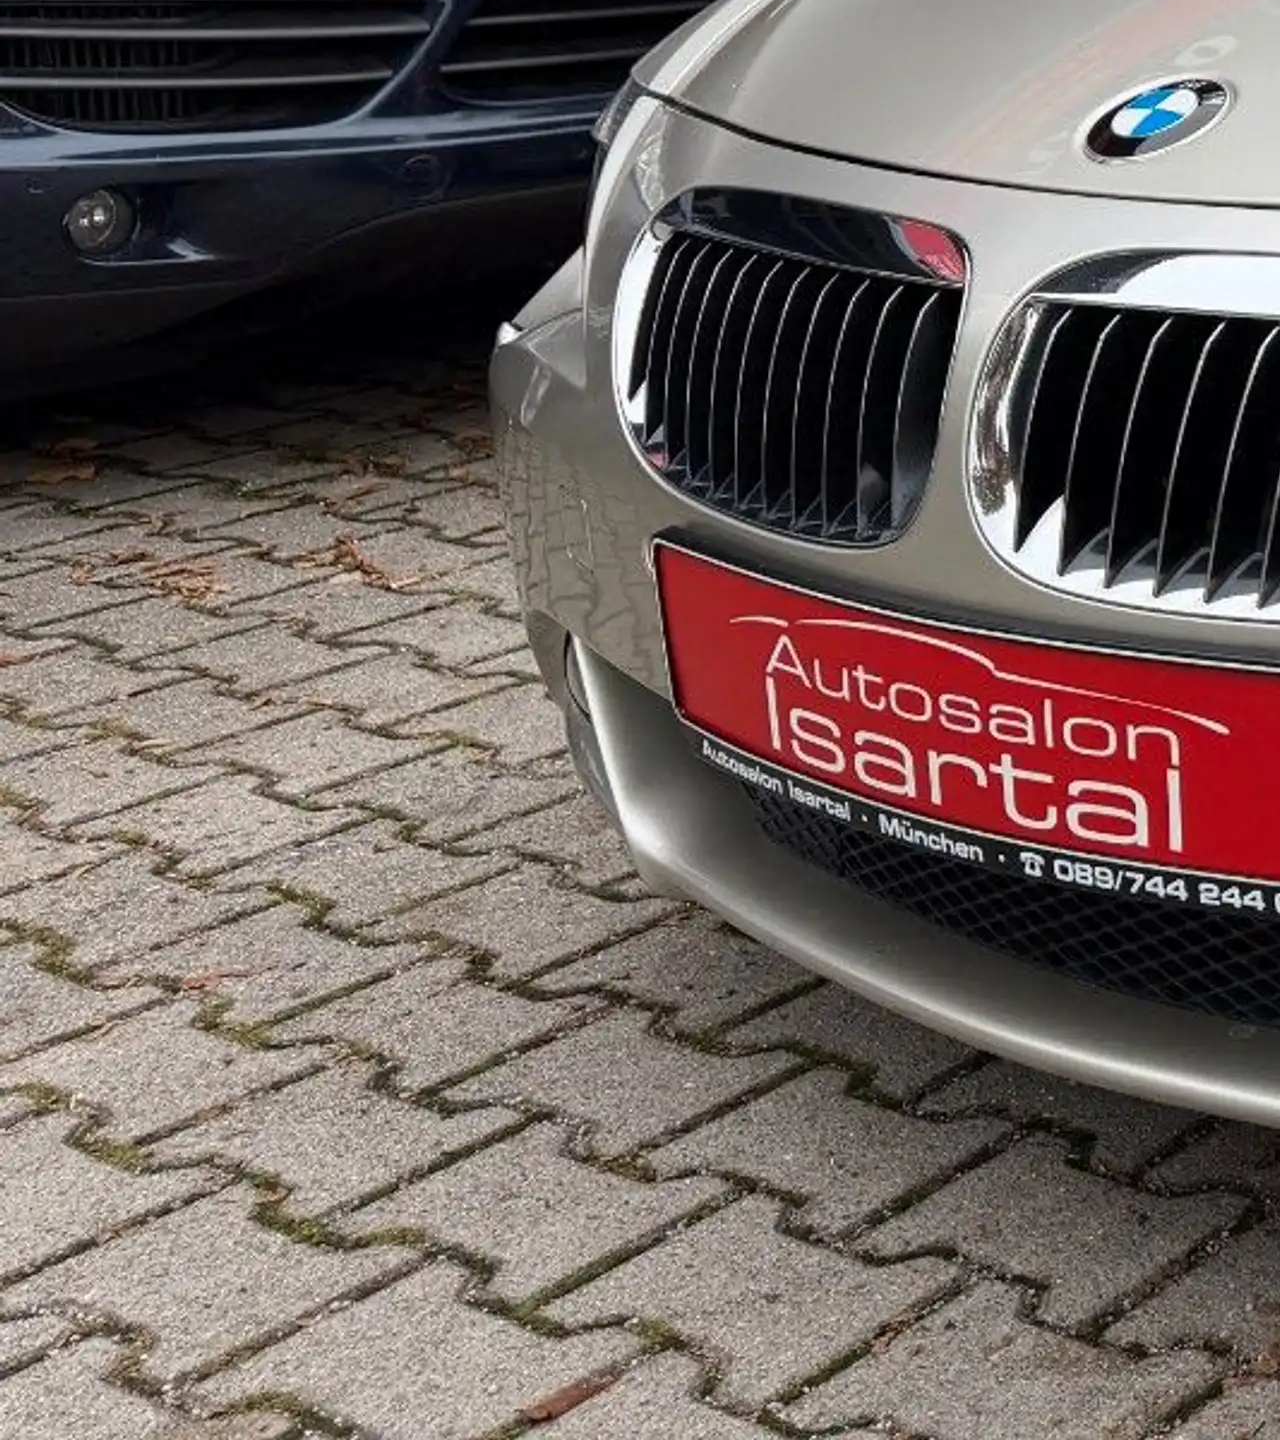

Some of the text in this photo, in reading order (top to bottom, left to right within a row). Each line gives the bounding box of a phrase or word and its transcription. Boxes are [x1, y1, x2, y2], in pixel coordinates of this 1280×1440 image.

[764, 635, 1181, 766] Autosalon
[764, 677, 1183, 852] Isartal
[702, 740, 783, 794] Autosalon
[787, 779, 850, 822] Isartal
[878, 813, 985, 863] München
[1053, 859, 1188, 902] 089/744
[1198, 882, 1267, 909] 244
